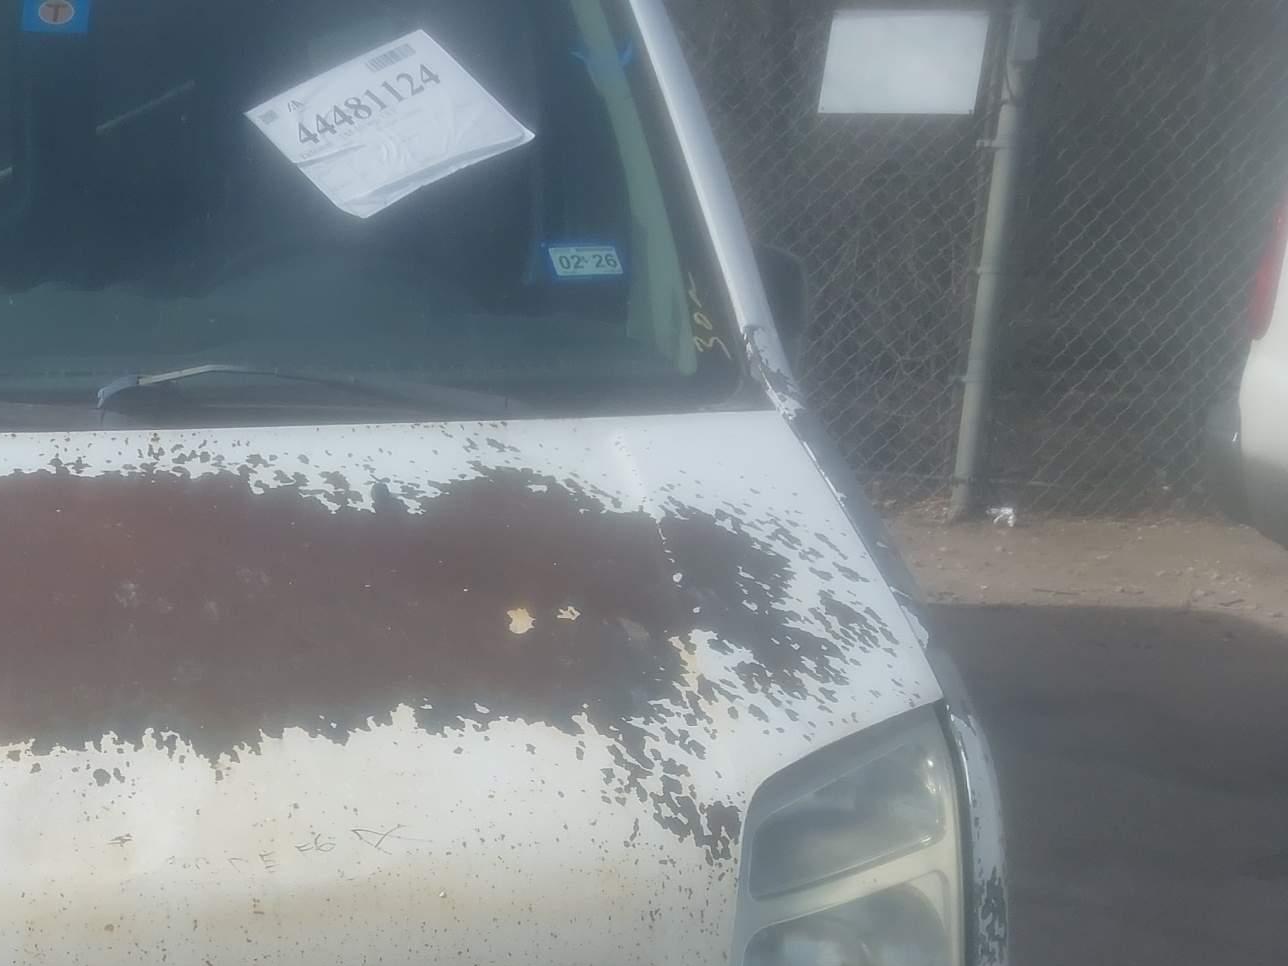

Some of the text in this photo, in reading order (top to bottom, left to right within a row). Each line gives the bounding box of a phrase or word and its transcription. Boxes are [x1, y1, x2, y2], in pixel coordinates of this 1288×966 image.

[297, 63, 441, 146] 44481124
[558, 253, 618, 270] 02 26
